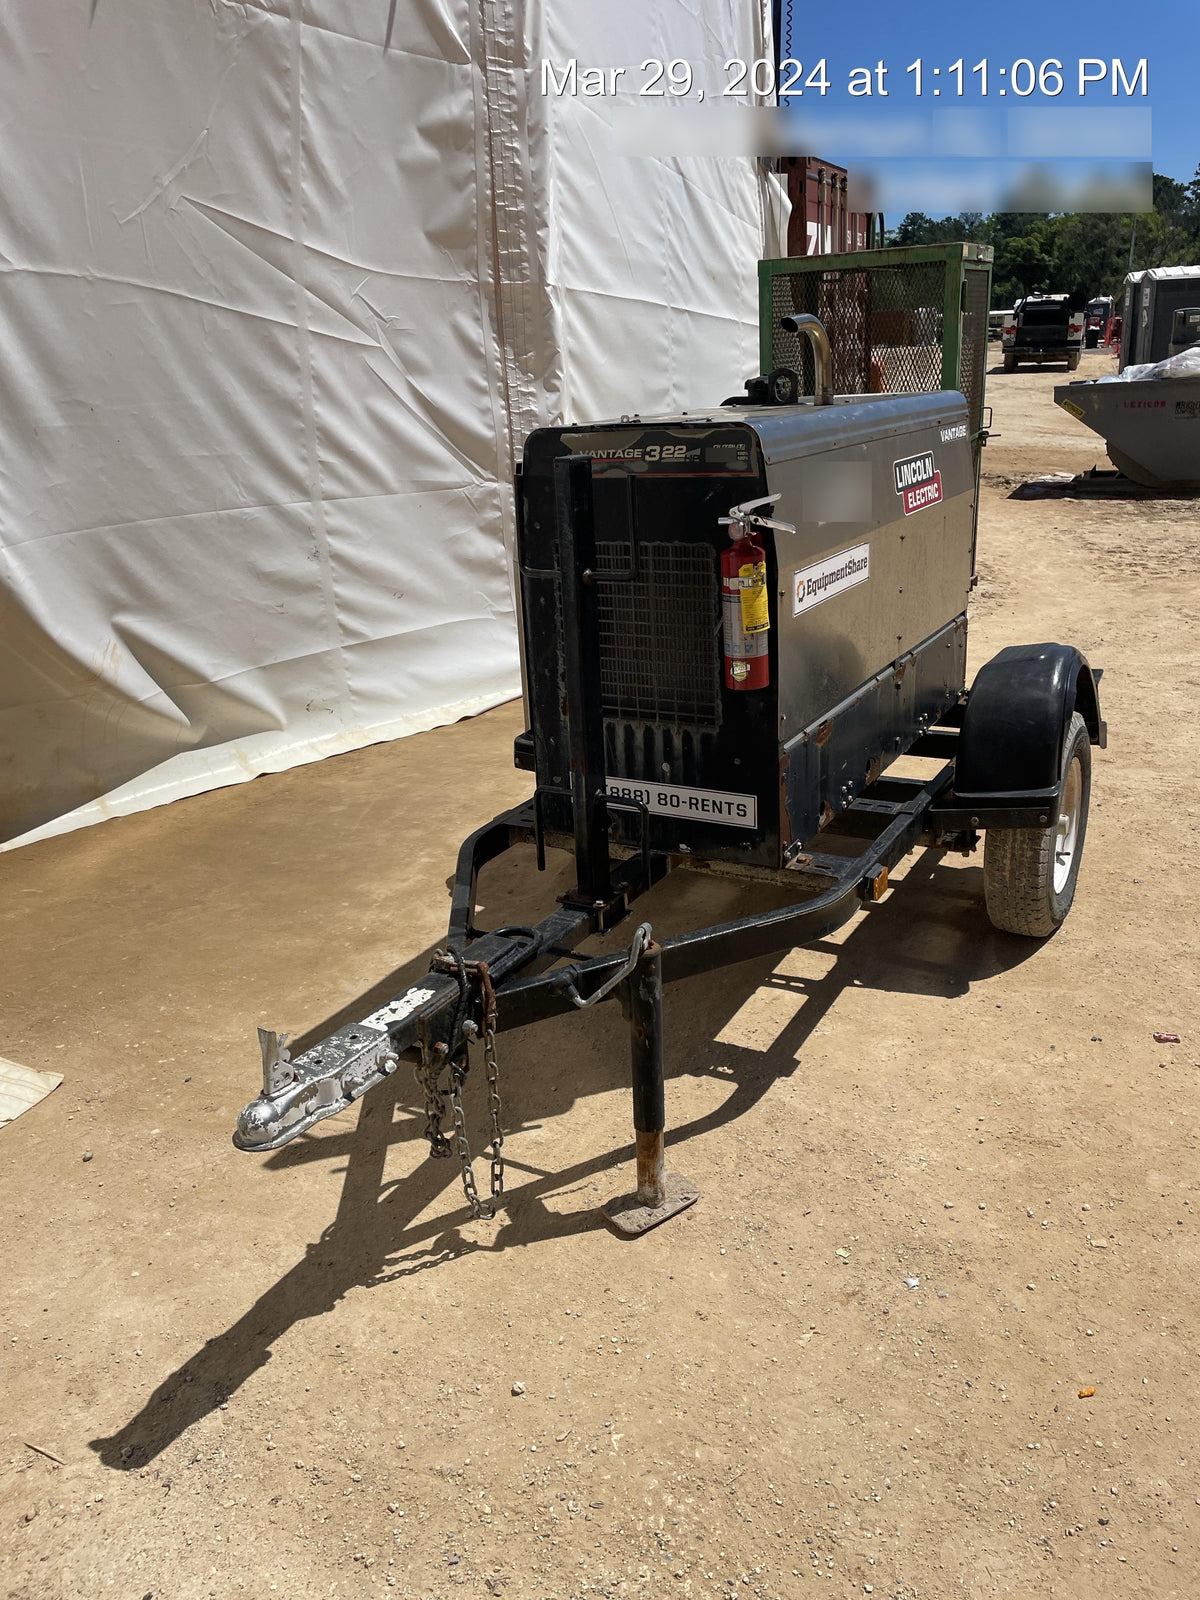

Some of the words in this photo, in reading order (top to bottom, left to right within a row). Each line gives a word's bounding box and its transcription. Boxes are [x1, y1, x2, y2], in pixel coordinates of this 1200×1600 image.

[940, 425, 967, 443] VANTAGE
[579, 448, 643, 459] VANTAGE
[644, 445, 687, 461] 322
[896, 456, 934, 489] LINCOLN
[907, 482, 940, 509] ELECTRIC
[806, 555, 868, 597] EquipmentShare
[606, 784, 651, 805] 888)
[657, 792, 748, 818] 80-RENTS
